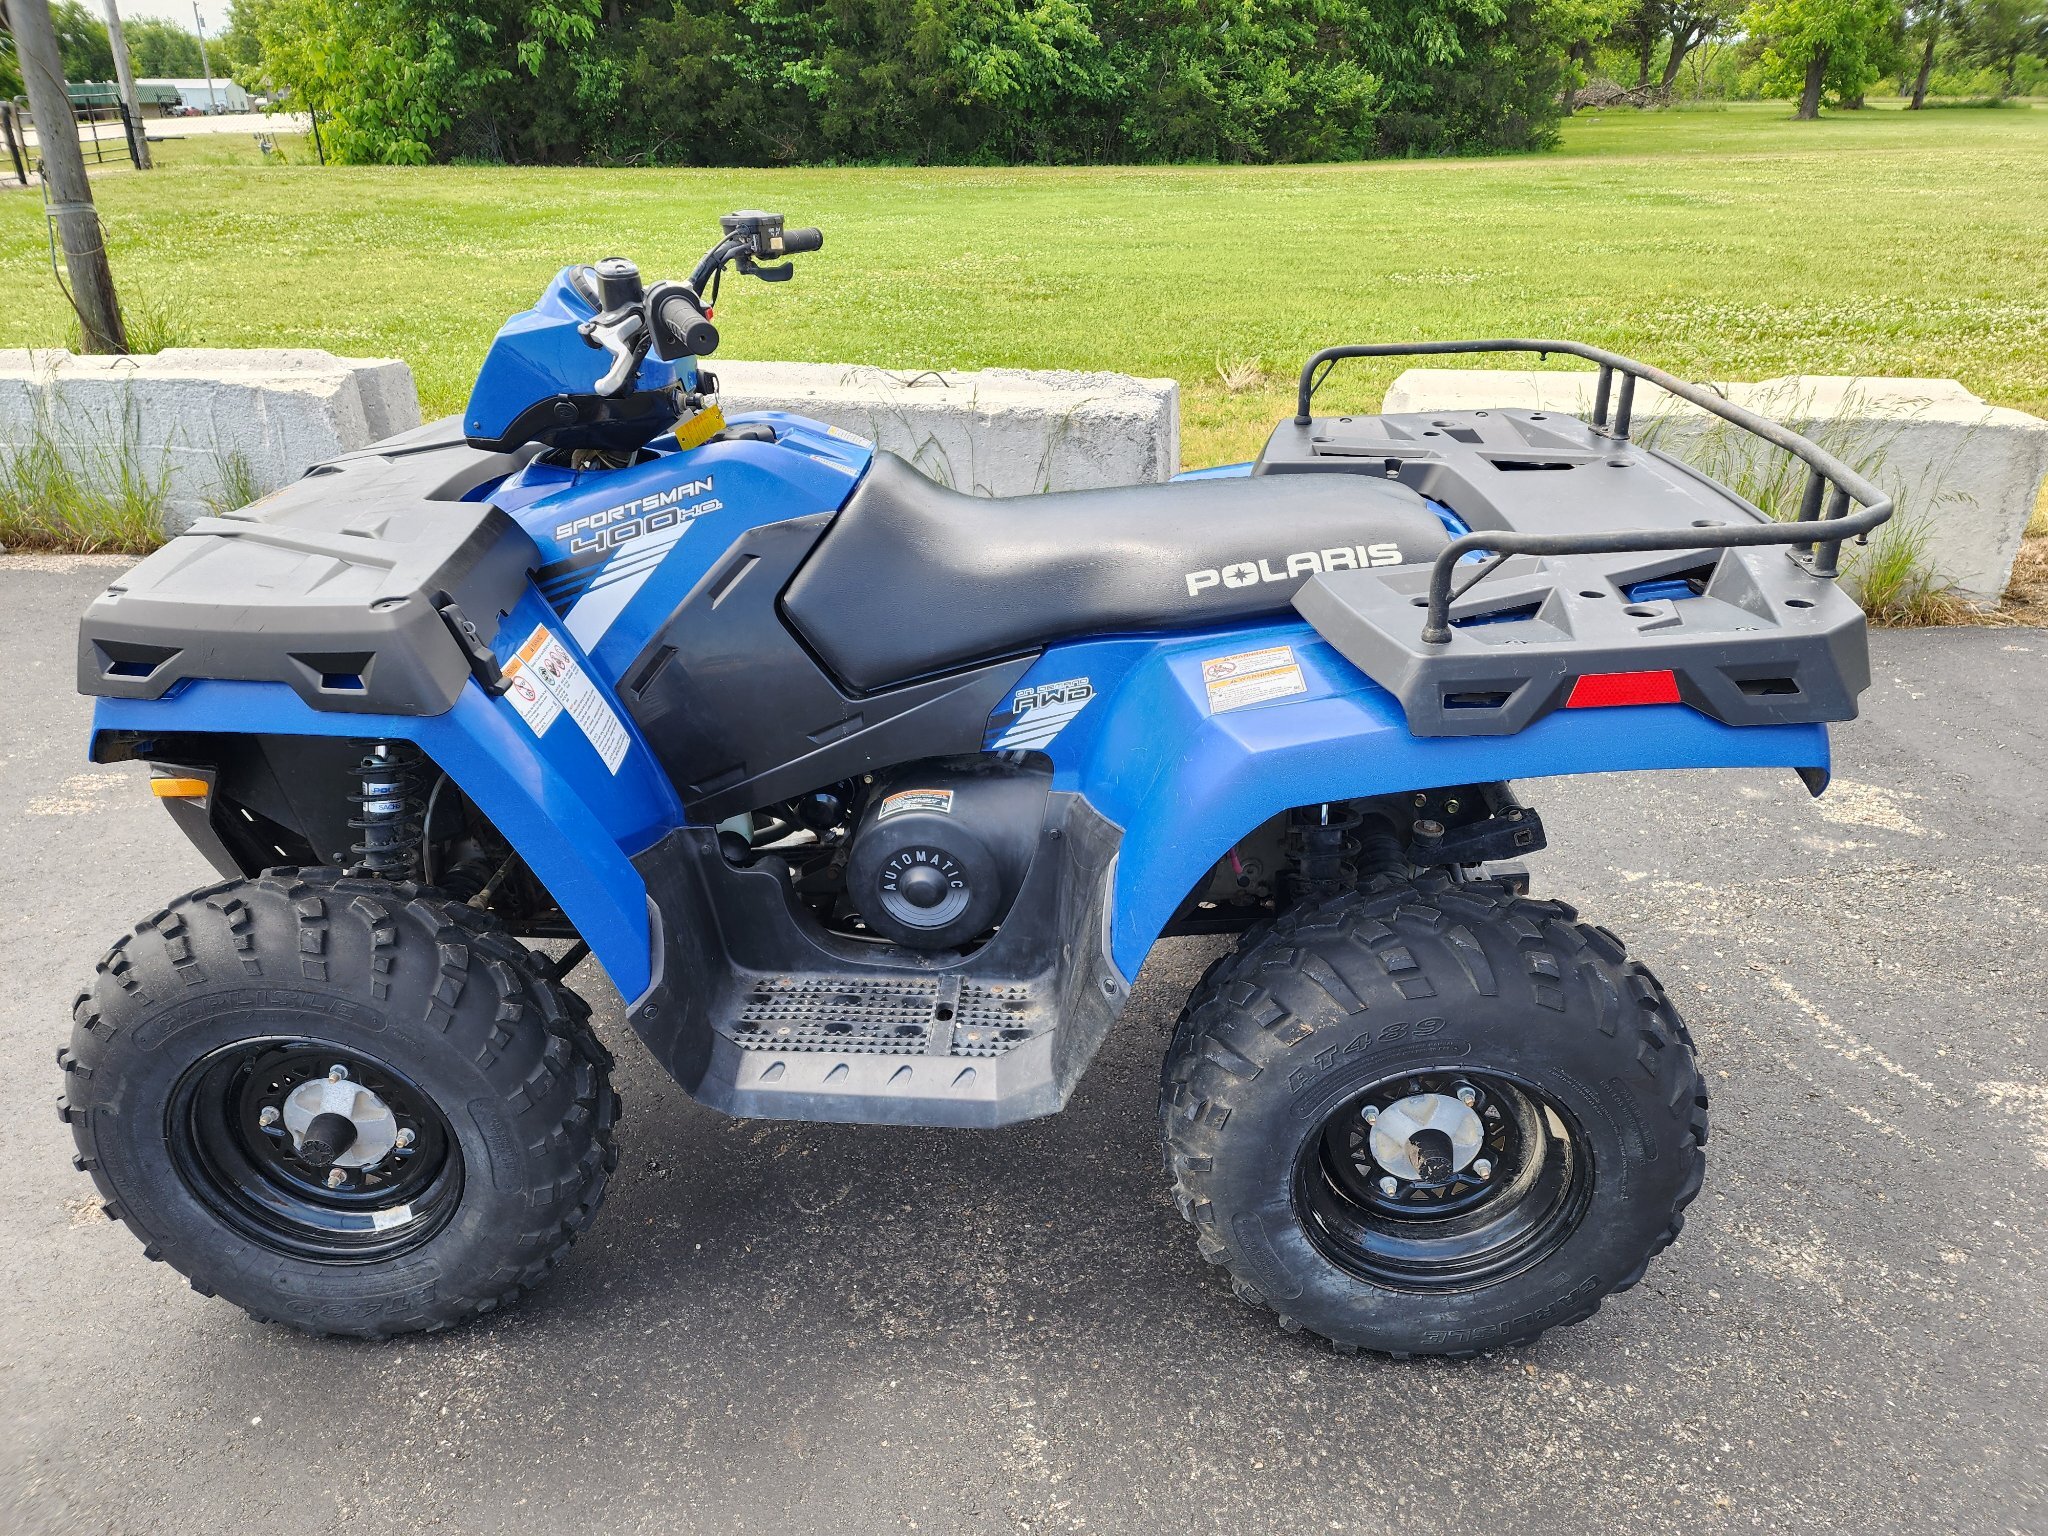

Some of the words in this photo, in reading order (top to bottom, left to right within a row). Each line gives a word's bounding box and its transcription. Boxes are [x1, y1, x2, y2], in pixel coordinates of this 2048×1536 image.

[555, 475, 714, 540] SPORTSMAN
[570, 506, 681, 554] 400
[1184, 543, 1403, 597] POLARIS
[1013, 685, 1092, 714] AWD
[883, 850, 964, 891] AUTOMATIC
